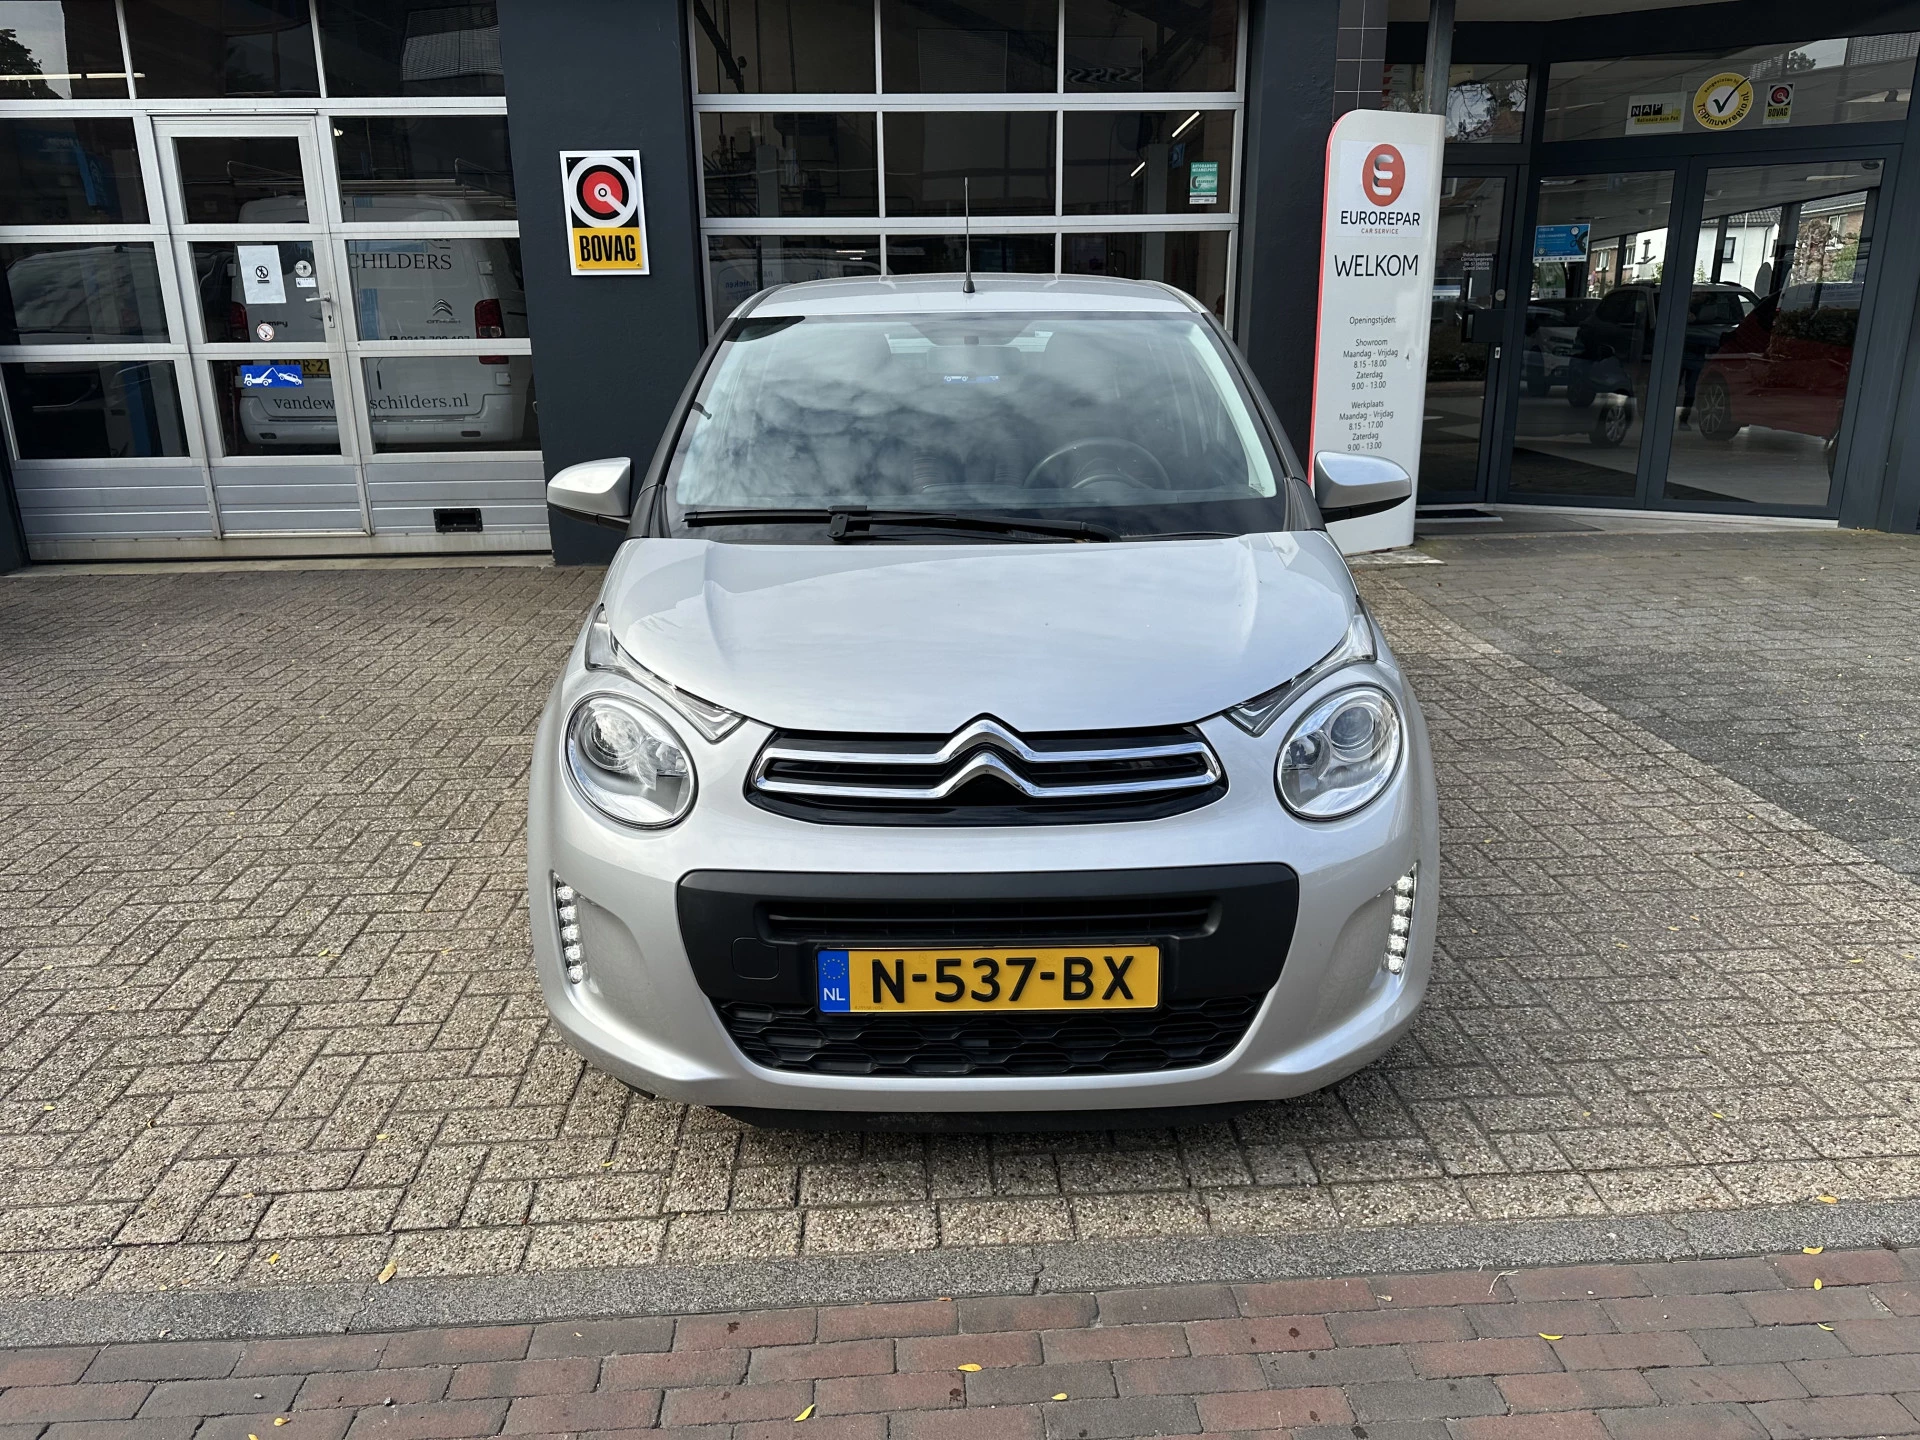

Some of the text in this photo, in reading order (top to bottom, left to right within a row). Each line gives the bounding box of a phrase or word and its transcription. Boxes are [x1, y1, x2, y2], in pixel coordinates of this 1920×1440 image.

[1632, 103, 1662, 116] NAP
[1768, 108, 1788, 117] BOVAG
[1340, 211, 1420, 226] EUROREPAR
[579, 234, 636, 262] BOVAG
[1334, 254, 1418, 277] WELKOM
[1350, 316, 1396, 326] Openingstijden:
[1343, 350, 1372, 358] Maandag
[1378, 349, 1398, 358] Vrijdag
[1354, 360, 1366, 368] 8.15
[1356, 371, 1383, 379] Zaterdag
[1352, 382, 1364, 390] 9.00
[1370, 381, 1386, 389] 13.00
[1351, 400, 1384, 410] Werkplaats
[1339, 412, 1367, 421] Maandag
[1373, 410, 1394, 419] Vrijdag
[1349, 422, 1361, 430] 8.15
[1368, 421, 1383, 429] 17.00
[1352, 432, 1379, 440] Zaterdag
[1348, 443, 1360, 451] 9.00
[1366, 441, 1382, 450] 13.00
[872, 956, 1134, 1004] N-537-BX
[823, 987, 846, 1002] NL
